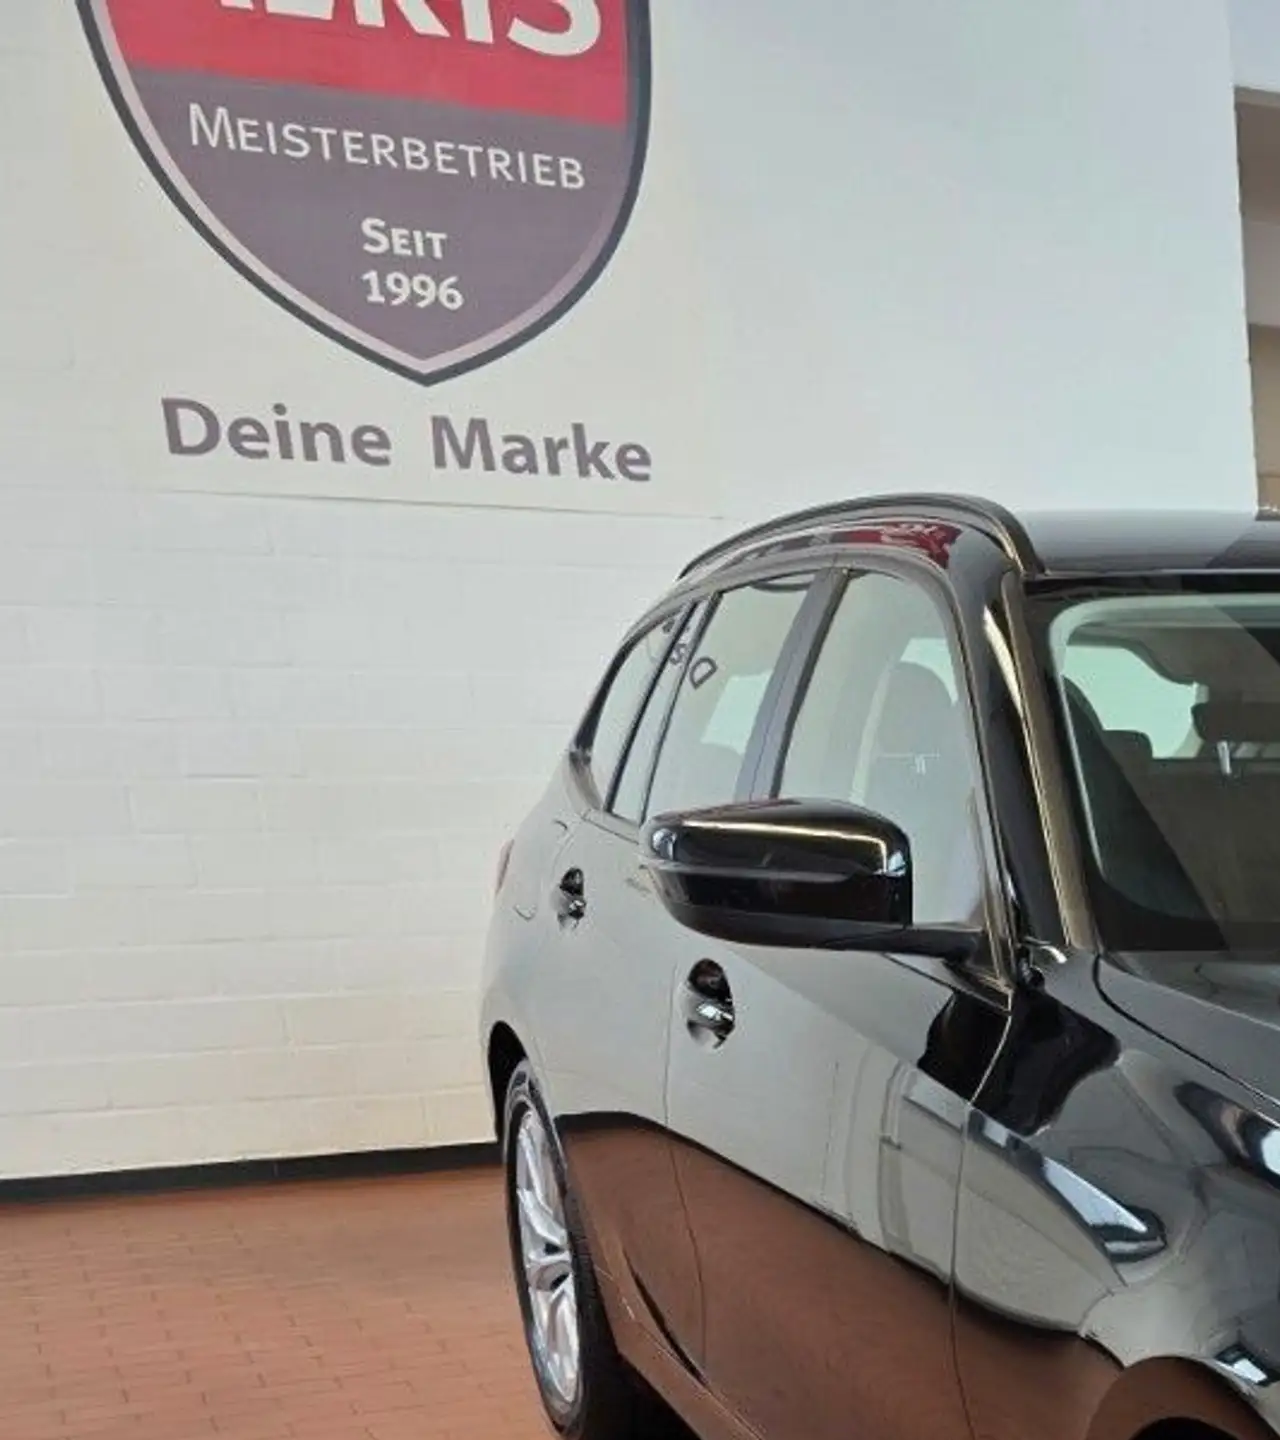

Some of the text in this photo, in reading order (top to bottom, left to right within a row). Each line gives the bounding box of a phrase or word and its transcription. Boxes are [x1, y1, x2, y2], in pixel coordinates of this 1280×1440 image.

[187, 101, 586, 191] MEISTERBETRIEB
[361, 217, 448, 261] SEIT
[360, 269, 465, 311] 1996
[160, 396, 653, 483] Deine Marke
